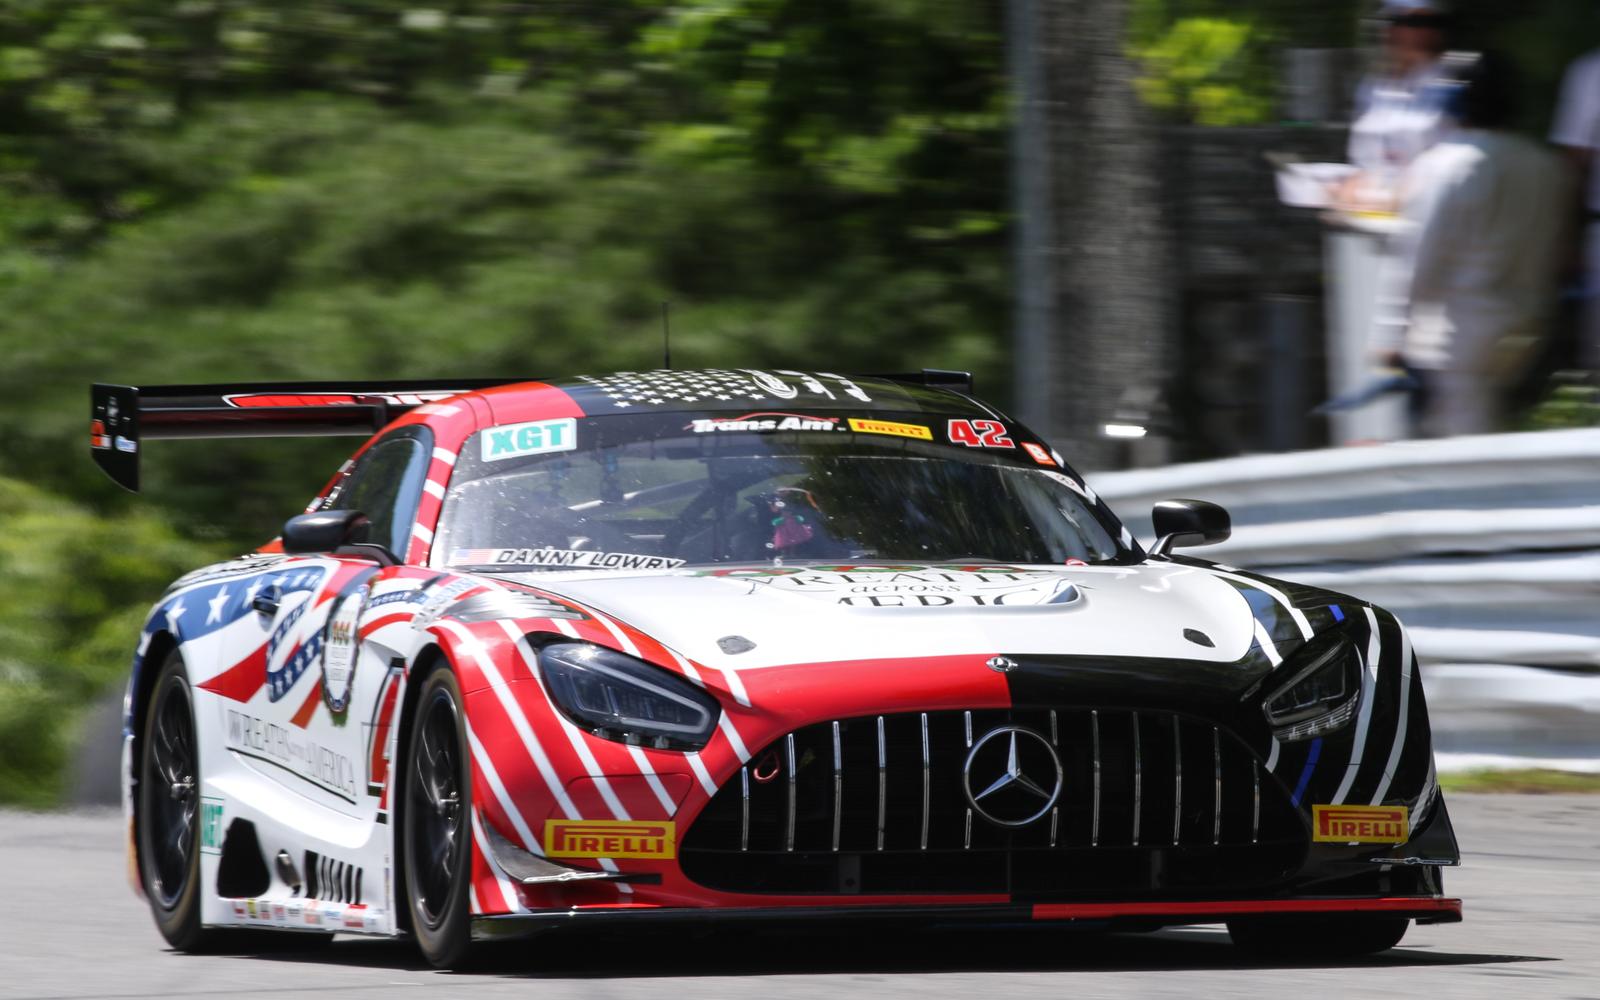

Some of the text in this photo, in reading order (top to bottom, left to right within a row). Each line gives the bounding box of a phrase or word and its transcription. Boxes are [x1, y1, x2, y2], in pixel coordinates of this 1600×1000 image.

[692, 416, 833, 433] Trans Am
[857, 420, 924, 437] PIRELLI
[948, 419, 1016, 449] 42
[490, 423, 568, 455] XGT
[498, 549, 681, 569] DANNY LOWRY
[850, 584, 962, 594] across
[1319, 810, 1403, 838] PIRELLI
[553, 825, 667, 854] PIRELLI
